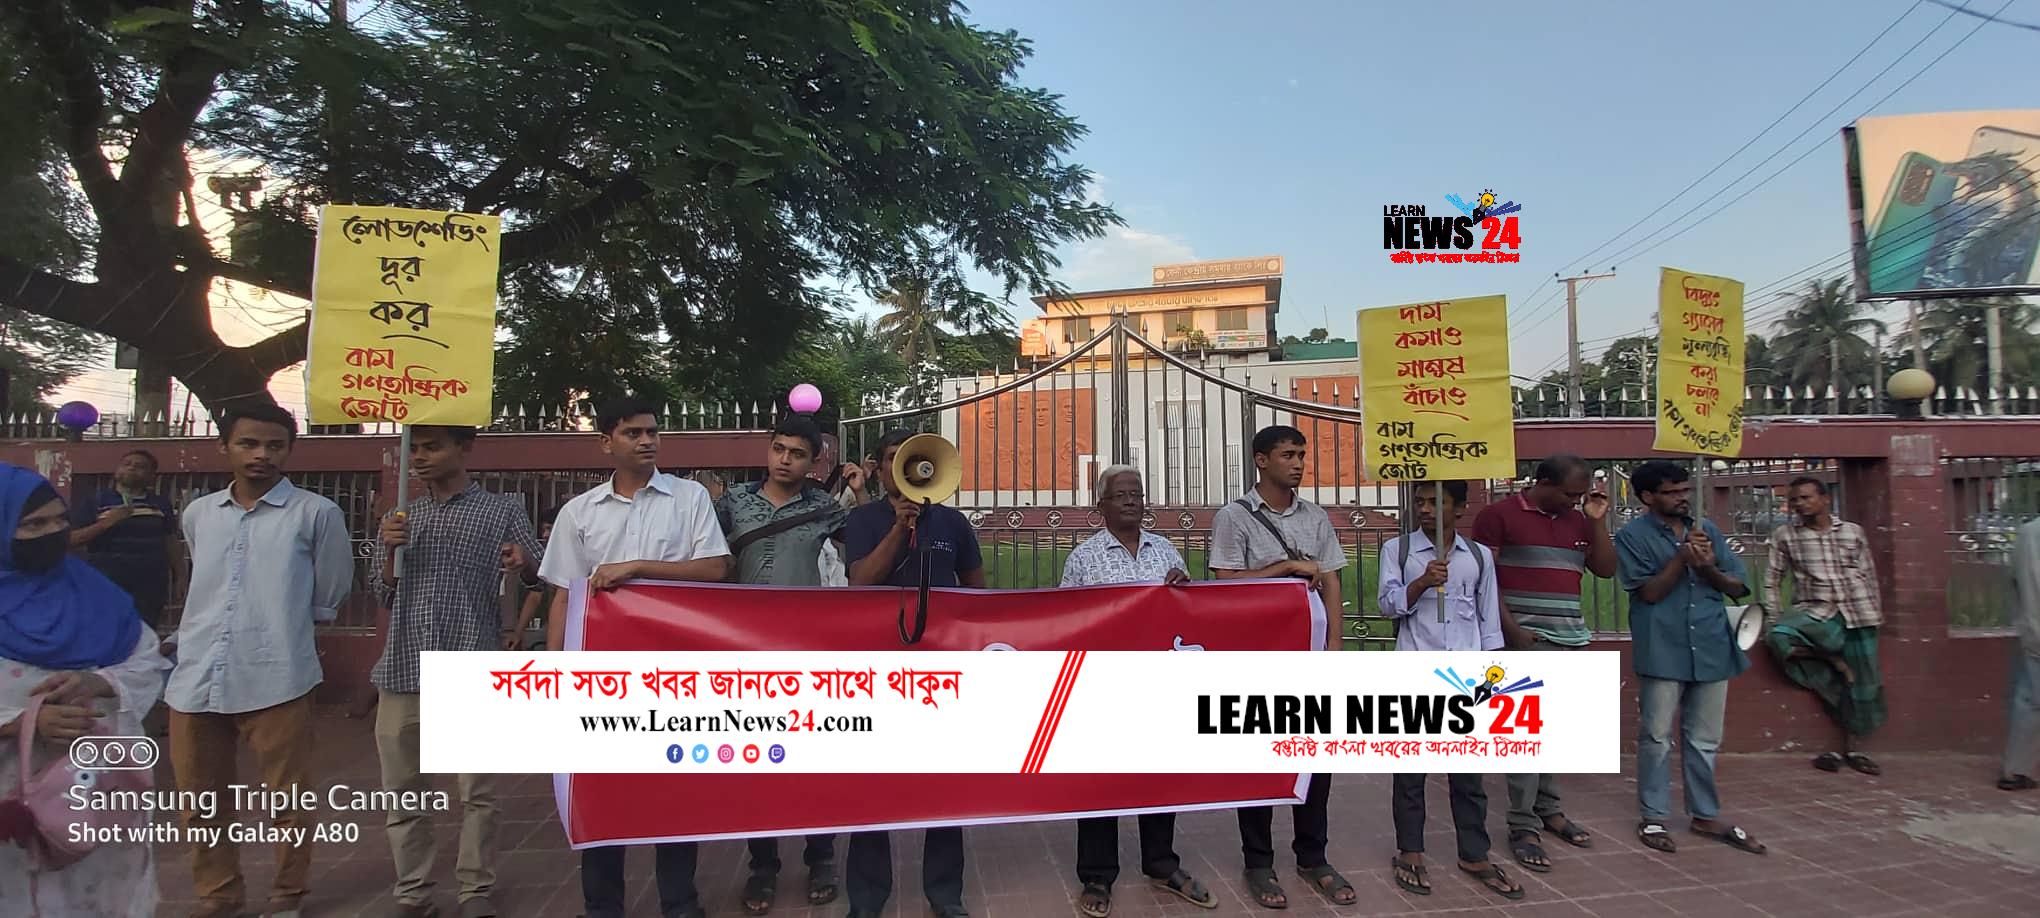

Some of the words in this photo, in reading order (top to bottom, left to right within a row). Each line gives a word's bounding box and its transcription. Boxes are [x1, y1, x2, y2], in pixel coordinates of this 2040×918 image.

[340, 214, 489, 252] লোডশেডিং
[377, 256, 425, 295] দূর
[370, 301, 432, 331] কর
[1400, 302, 1450, 324] দাম
[1394, 326, 1462, 349] কমাও
[344, 347, 394, 369] বাম
[1396, 356, 1465, 380] মানুষ
[341, 365, 469, 401] গণতান্ত্রিক
[1403, 383, 1467, 406] বাঁচাও
[341, 393, 409, 420] জোট
[1376, 421, 1414, 439] বাম
[1379, 433, 1488, 462] গণতান্ত্রিক
[1378, 457, 1427, 480] জোট
